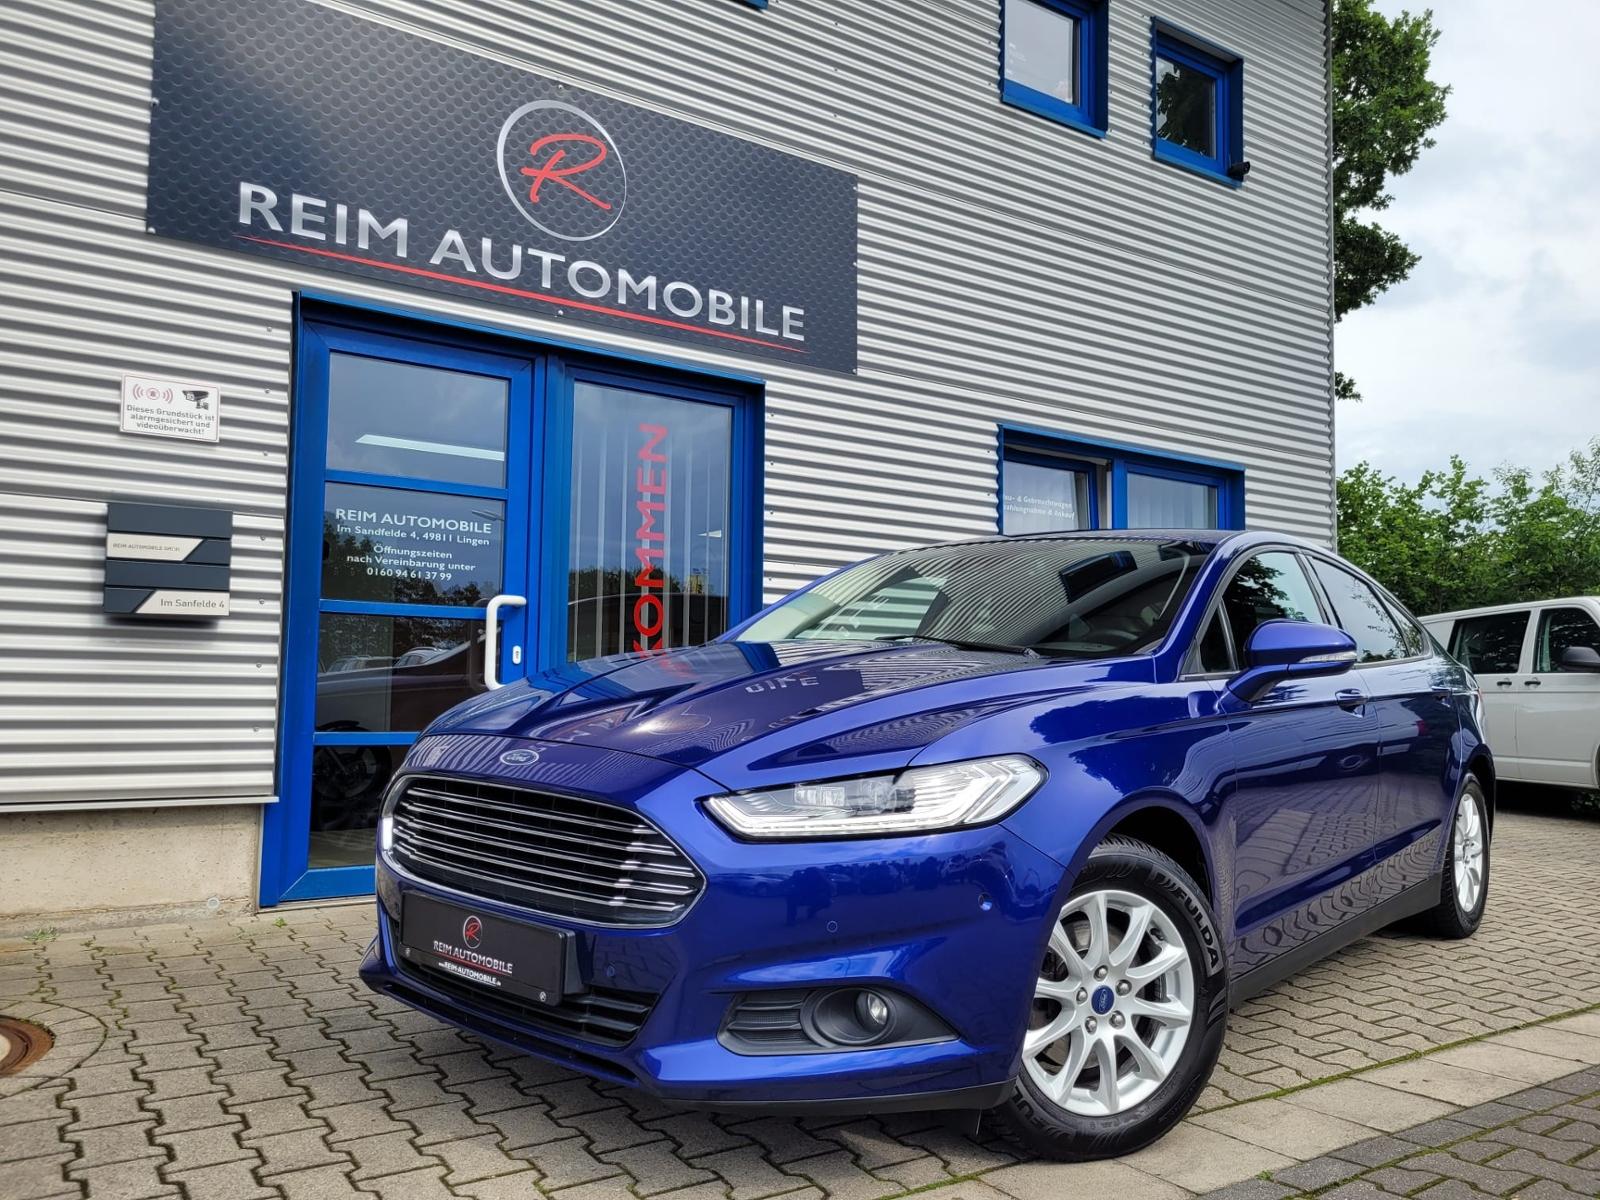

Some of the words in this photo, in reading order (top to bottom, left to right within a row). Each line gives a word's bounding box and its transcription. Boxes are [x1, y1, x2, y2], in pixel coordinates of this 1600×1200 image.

[520, 133, 612, 210] R
[239, 181, 408, 258] REIM
[429, 229, 805, 342] AUTOMOBILE
[127, 404, 154, 414] Dieses
[156, 408, 203, 420] Grundstück
[130, 413, 193, 426] alarmgesichert
[195, 420, 210, 428] und
[136, 422, 204, 435] videoüberwacht!
[335, 508, 376, 523] REIM
[380, 513, 492, 533] AUTOMOBILE
[336, 524, 351, 533] Im
[355, 525, 407, 538] Sandfelde
[410, 531, 420, 541] 4,
[422, 532, 453, 543] 49811
[456, 535, 490, 547] Lingen
[373, 543, 452, 559] Öffnungszeiten
[346, 555, 372, 564] nach
[375, 555, 445, 571] Vereinbarung
[448, 563, 476, 571] unter
[366, 567, 393, 577] 0160
[395, 568, 408, 578] 94
[410, 570, 422, 579] 61
[424, 571, 439, 580] 37
[439, 572, 452, 581] 99
[160, 598, 173, 607] Im
[175, 599, 217, 608] Sanfelde
[218, 600, 225, 608] 4
[1175, 886, 1220, 969] FULDA
[433, 940, 453, 954] REIM
[453, 945, 514, 974] AUTOMOBILE
